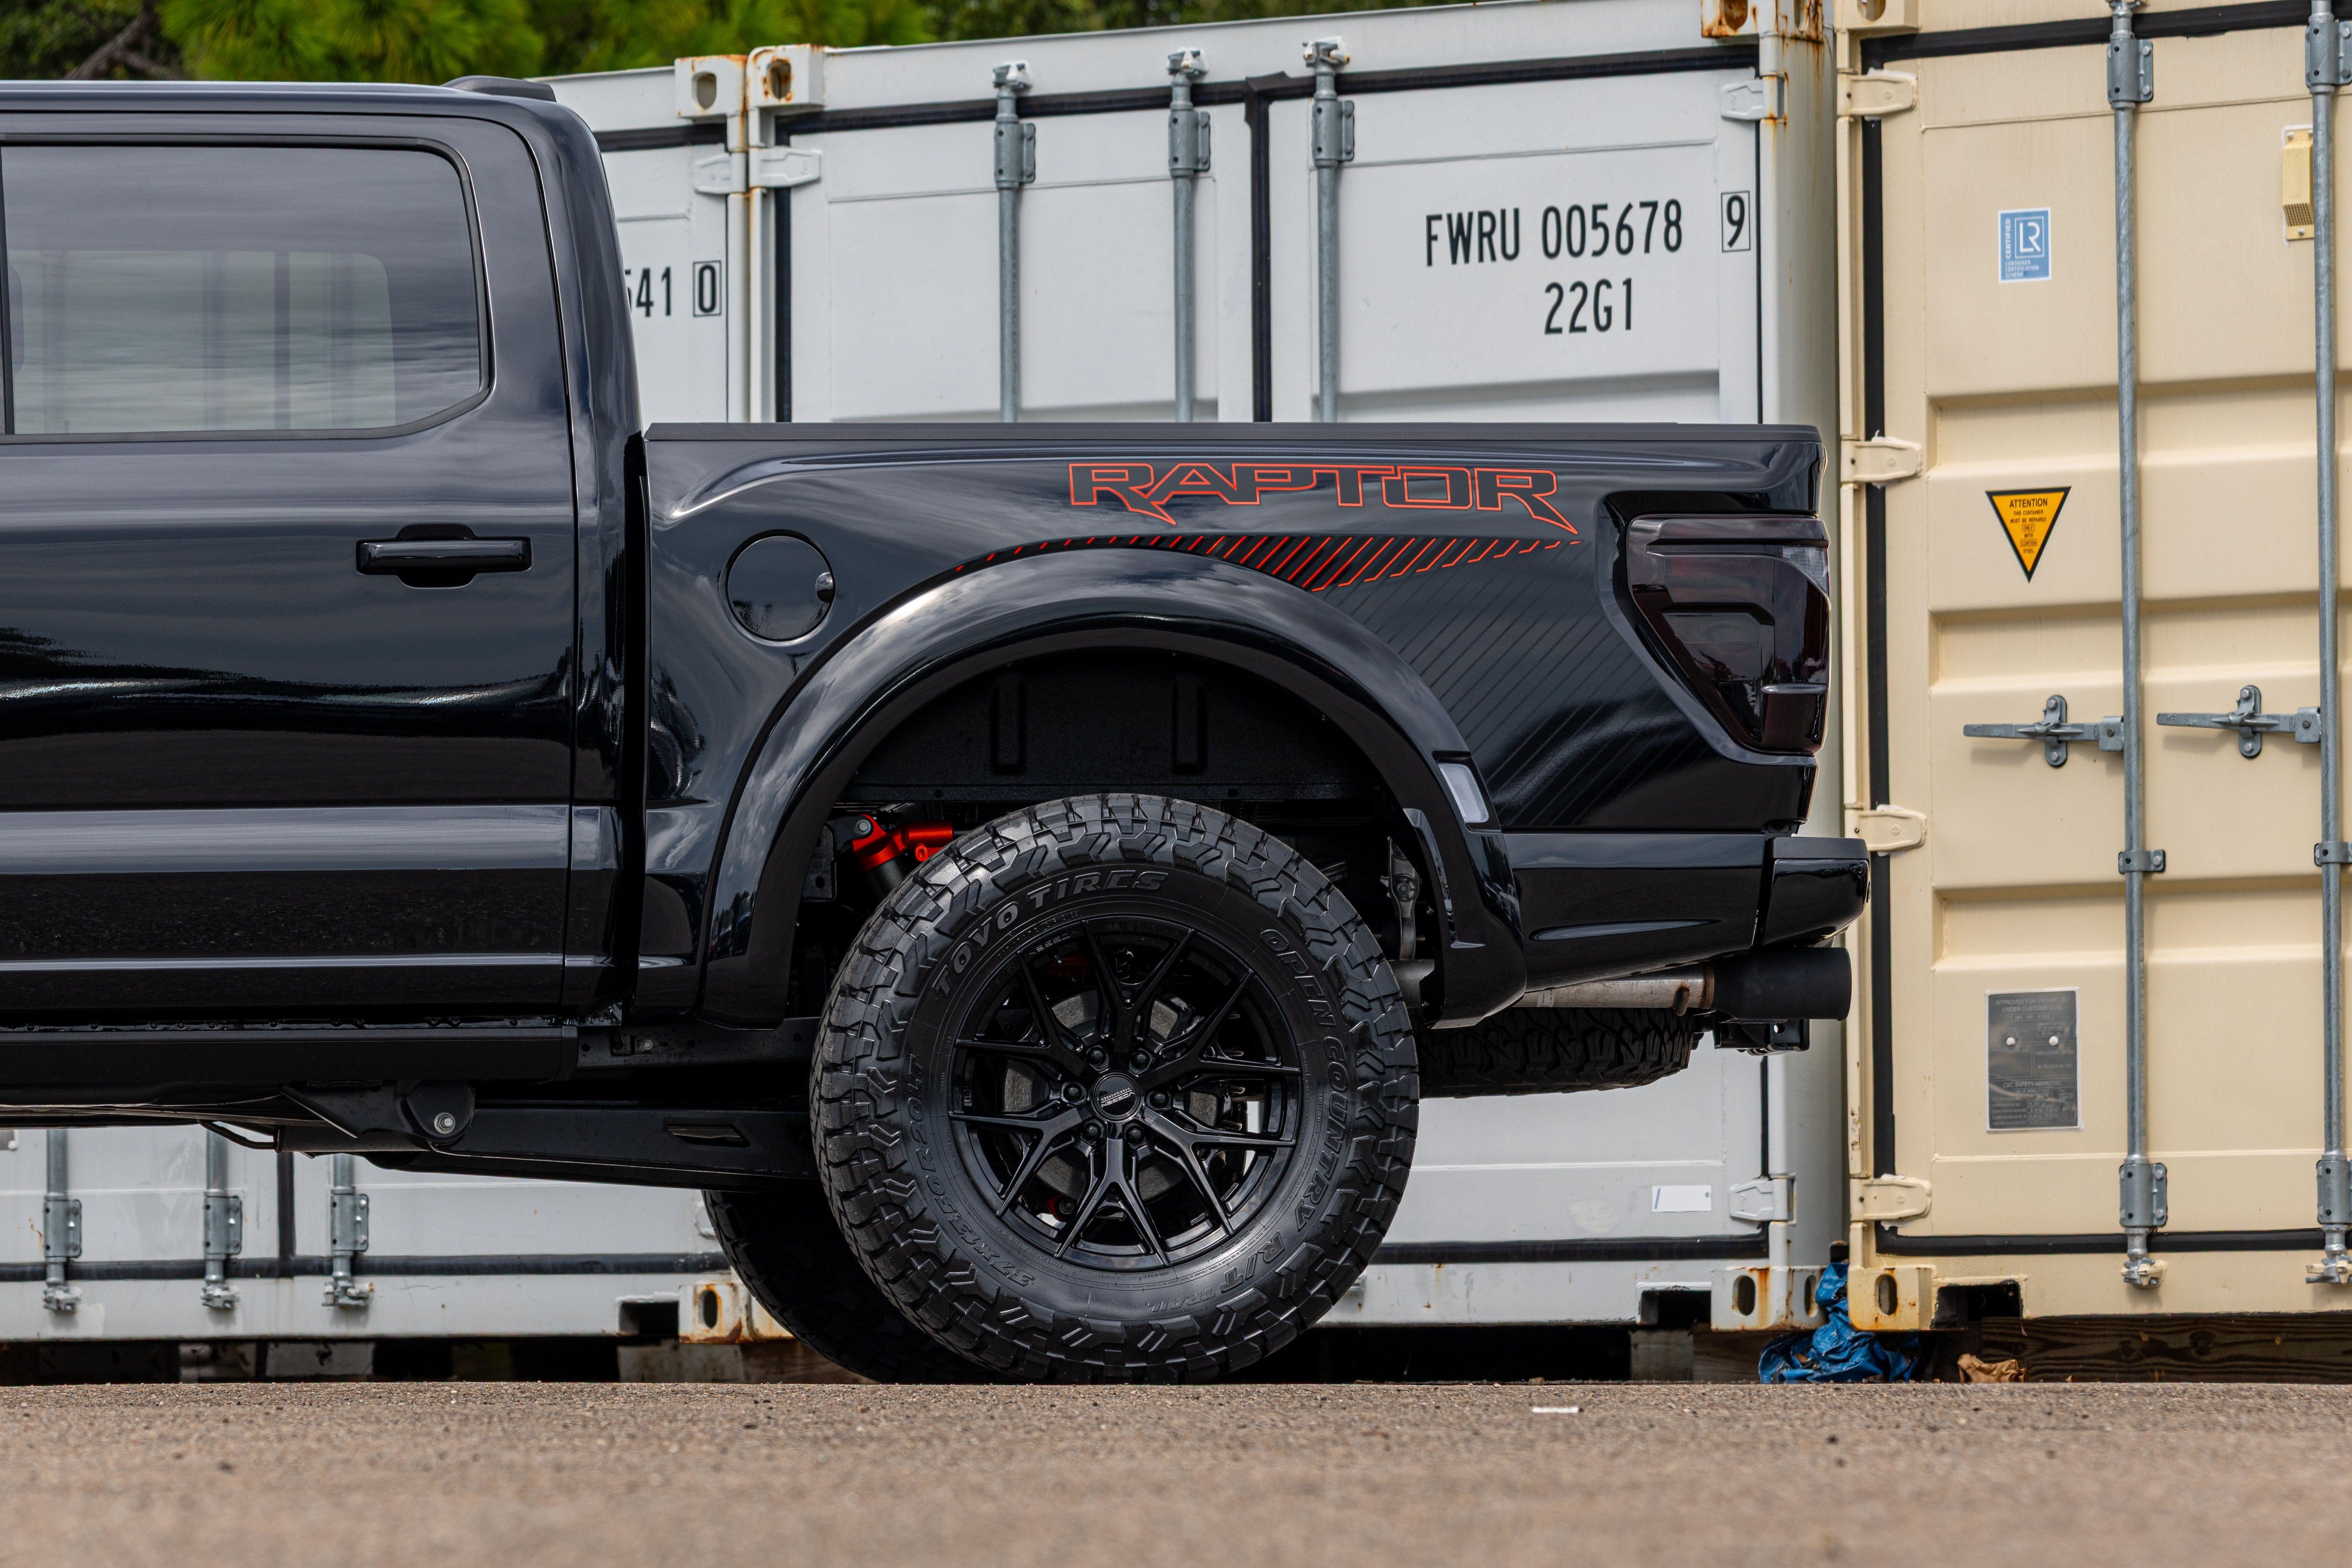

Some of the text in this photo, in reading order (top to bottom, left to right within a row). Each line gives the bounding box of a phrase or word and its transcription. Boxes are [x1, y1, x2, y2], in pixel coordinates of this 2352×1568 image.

[1425, 194, 1745, 267] FWRU 005678 9
[2020, 222, 2041, 253] LR
[699, 264, 716, 313] 0
[1544, 277, 1633, 335] 22G1
[1068, 462, 1579, 535] RAPTOR
[2009, 498, 2047, 508] ATTENTION
[933, 900, 1022, 997] TOYO
[1027, 871, 1168, 907] TIRES
[1260, 926, 1337, 1028] OPEN
[1101, 1092, 1134, 1108] VOSSEN
[1292, 1036, 1348, 1230] COUNTRY
[1218, 1231, 1289, 1292] R/T
[1147, 1287, 1216, 1313] TRAIL
